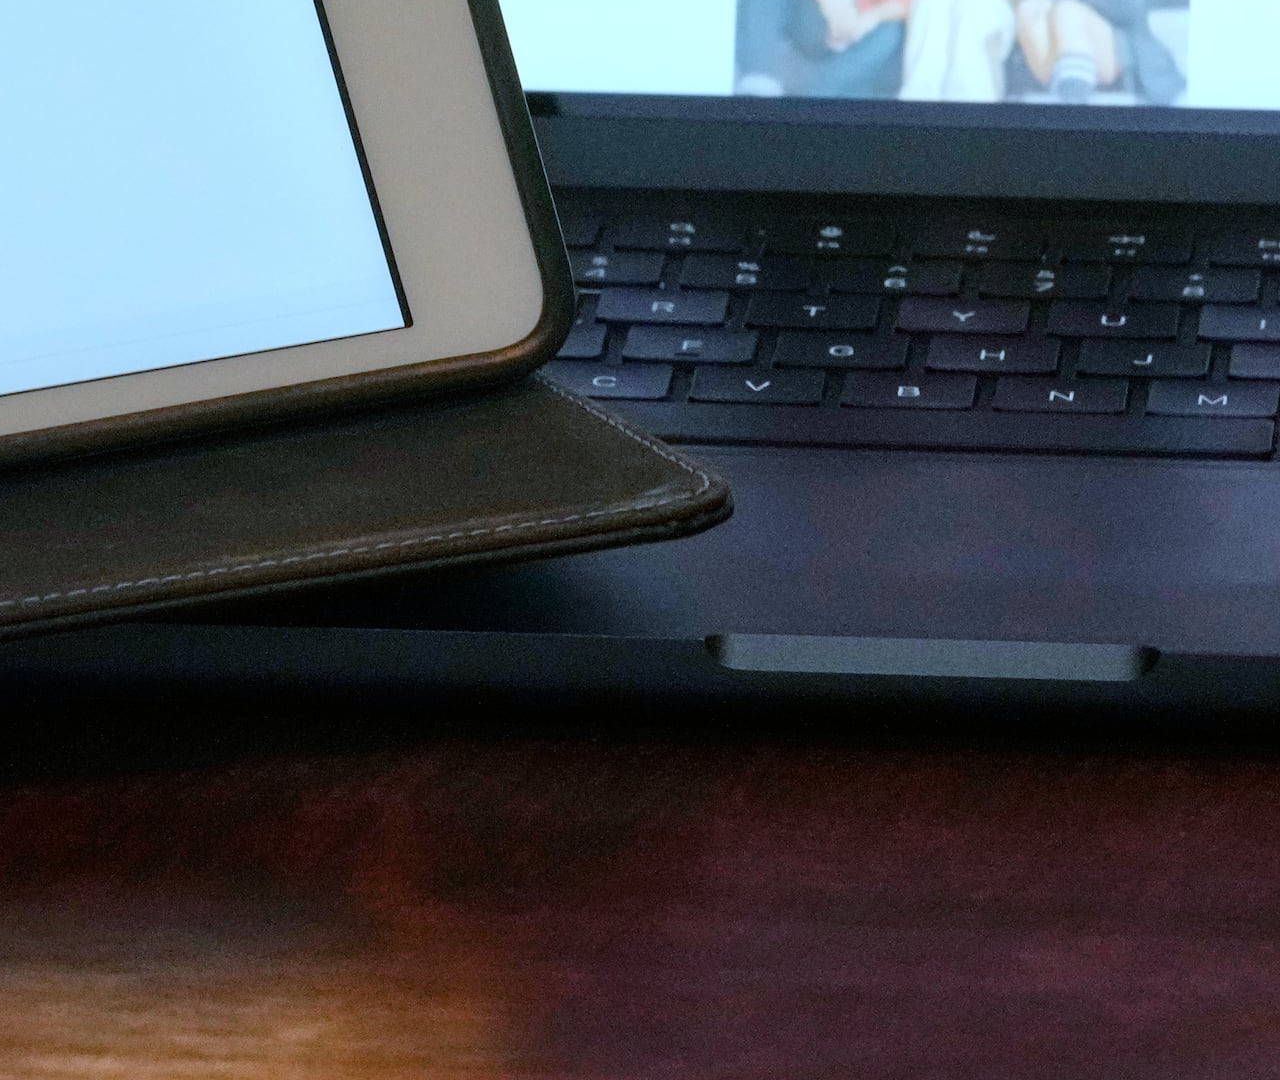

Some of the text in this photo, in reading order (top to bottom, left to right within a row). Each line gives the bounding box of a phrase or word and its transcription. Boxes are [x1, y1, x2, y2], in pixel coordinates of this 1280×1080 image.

[652, 301, 675, 313] R
[802, 305, 826, 317] T
[952, 311, 976, 323] Y
[1101, 315, 1126, 327] U
[980, 349, 1005, 361] H
[1133, 354, 1154, 366] J
[592, 376, 617, 388] C
[746, 379, 771, 393] V
[1050, 390, 1074, 402] N
[1198, 394, 1228, 407] M
